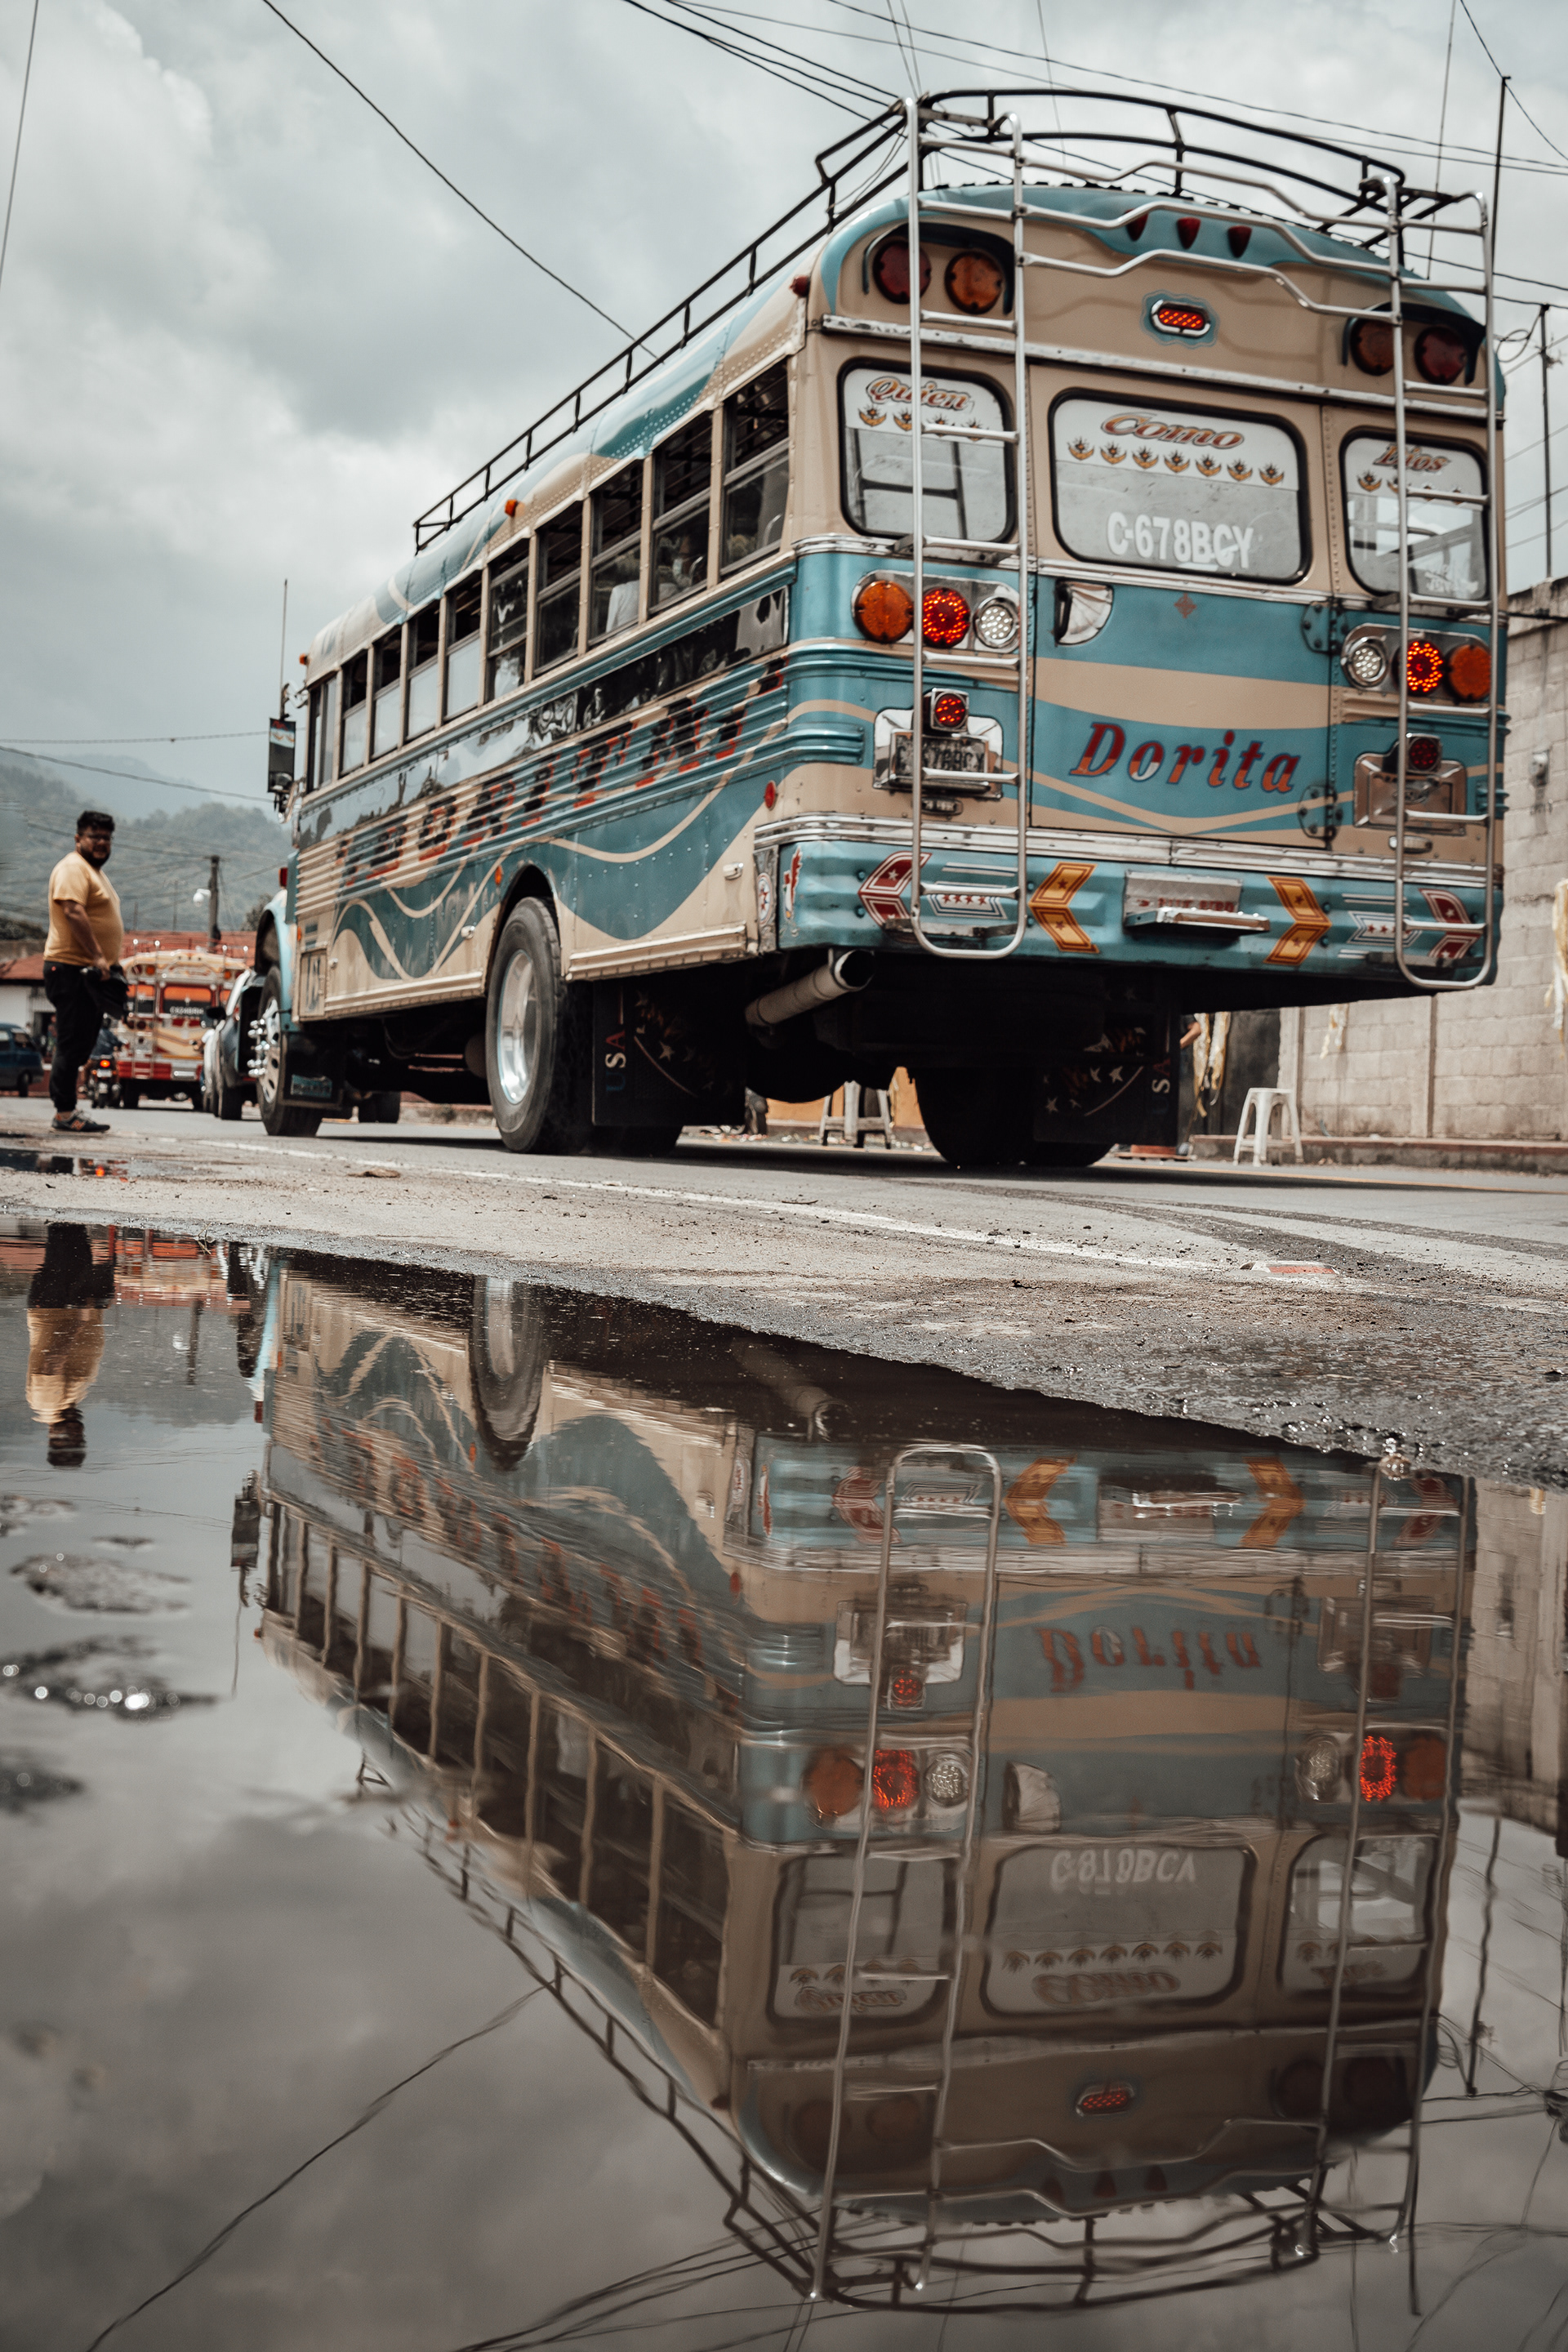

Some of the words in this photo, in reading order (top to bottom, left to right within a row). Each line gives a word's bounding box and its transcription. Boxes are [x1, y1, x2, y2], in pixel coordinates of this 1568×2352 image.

[866, 376, 971, 411] Quien
[1101, 412, 1245, 449] Como
[1107, 511, 1254, 569] C-678BCY
[1069, 722, 1301, 793] Dorita
